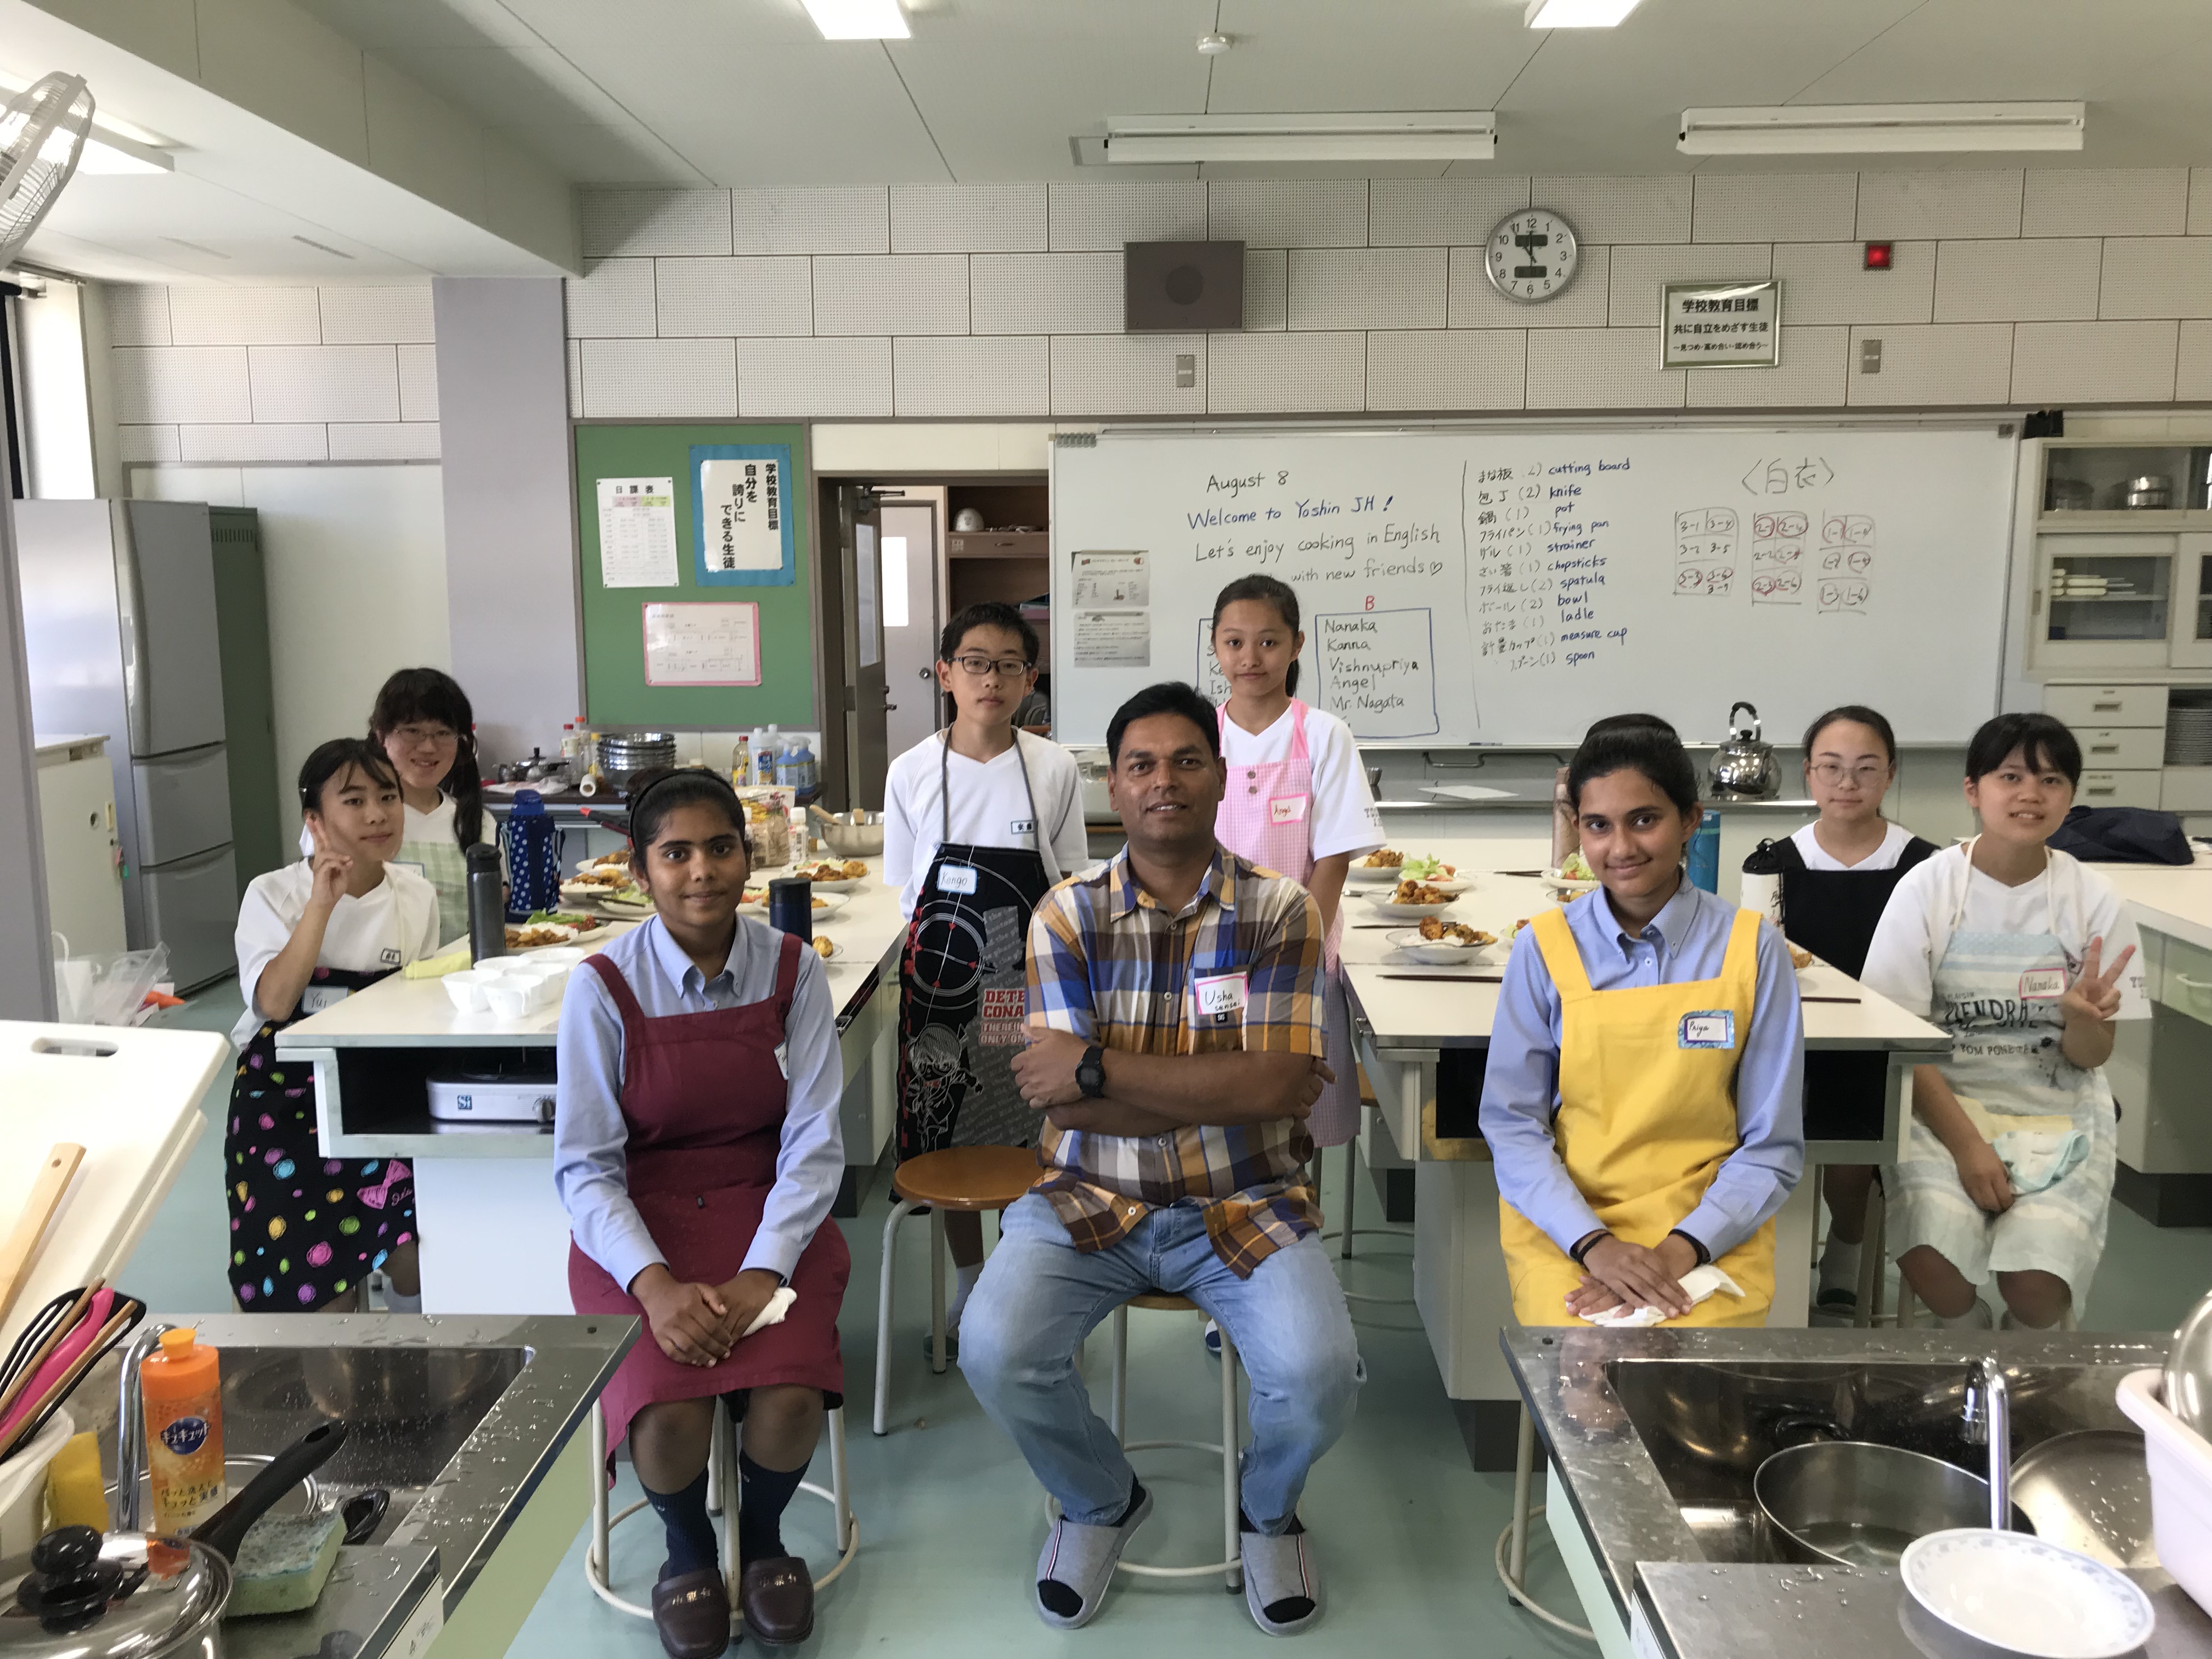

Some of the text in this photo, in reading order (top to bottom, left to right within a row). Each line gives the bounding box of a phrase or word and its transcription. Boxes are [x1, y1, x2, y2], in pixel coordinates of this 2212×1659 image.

[1511, 223, 1520, 233] 11
[1526, 218, 1537, 228] 12
[1546, 222, 1550, 232] 1
[1499, 235, 1509, 245] 10
[1556, 233, 1564, 244] 2
[1495, 252, 1502, 262] 9
[1560, 251, 1567, 261] 3
[1499, 269, 1506, 279] 8
[1554, 268, 1561, 278] 4
[1511, 280, 1518, 290] 7
[1527, 284, 1534, 294] 6
[1543, 280, 1550, 290] 5
[1682, 297, 1759, 313] 学校教育目標
[1548, 458, 1630, 476] cutting board
[745, 464, 757, 503] 自分を
[1206, 470, 1289, 498] August 8
[1549, 483, 1582, 500] knife
[732, 483, 746, 522] 誇りに
[765, 463, 778, 531] 学校教育目標
[1187, 506, 1257, 530] Welcome
[1265, 507, 1282, 521] to
[1295, 499, 1340, 518] Yoshin
[1351, 495, 1375, 512] JH
[1555, 501, 1576, 519] pot
[1553, 520, 1610, 537] frying pan
[1680, 521, 1699, 533] 3-1
[720, 504, 735, 569] できる生徒
[1195, 522, 1441, 564] Let's enjoy cooking in English
[1547, 539, 1596, 553] strainer
[1710, 542, 1731, 554] 3-5
[1291, 555, 1425, 582] with new friends
[1547, 555, 1607, 573] chopsticks
[1560, 571, 1605, 591] spatula
[1777, 577, 1797, 587] 2-6
[1365, 595, 1375, 611] B
[1557, 590, 1588, 607] bowl
[1561, 607, 1594, 623] ladle
[1325, 618, 1378, 633] Nanaka
[1327, 637, 1371, 652] Kanna
[1560, 627, 1628, 646] measure cup
[1565, 651, 1595, 667] spoon
[1329, 657, 1419, 678] Vishnupriya
[1330, 673, 1376, 695] Angel
[1330, 693, 1404, 714] Mr. Nagata
[984, 990, 1025, 1003] DETE
[1205, 989, 1233, 1006] Usha
[1215, 998, 1240, 1011] sensei
[983, 1005, 1024, 1018] CONA
[161, 1422, 211, 1445] キュキュット
